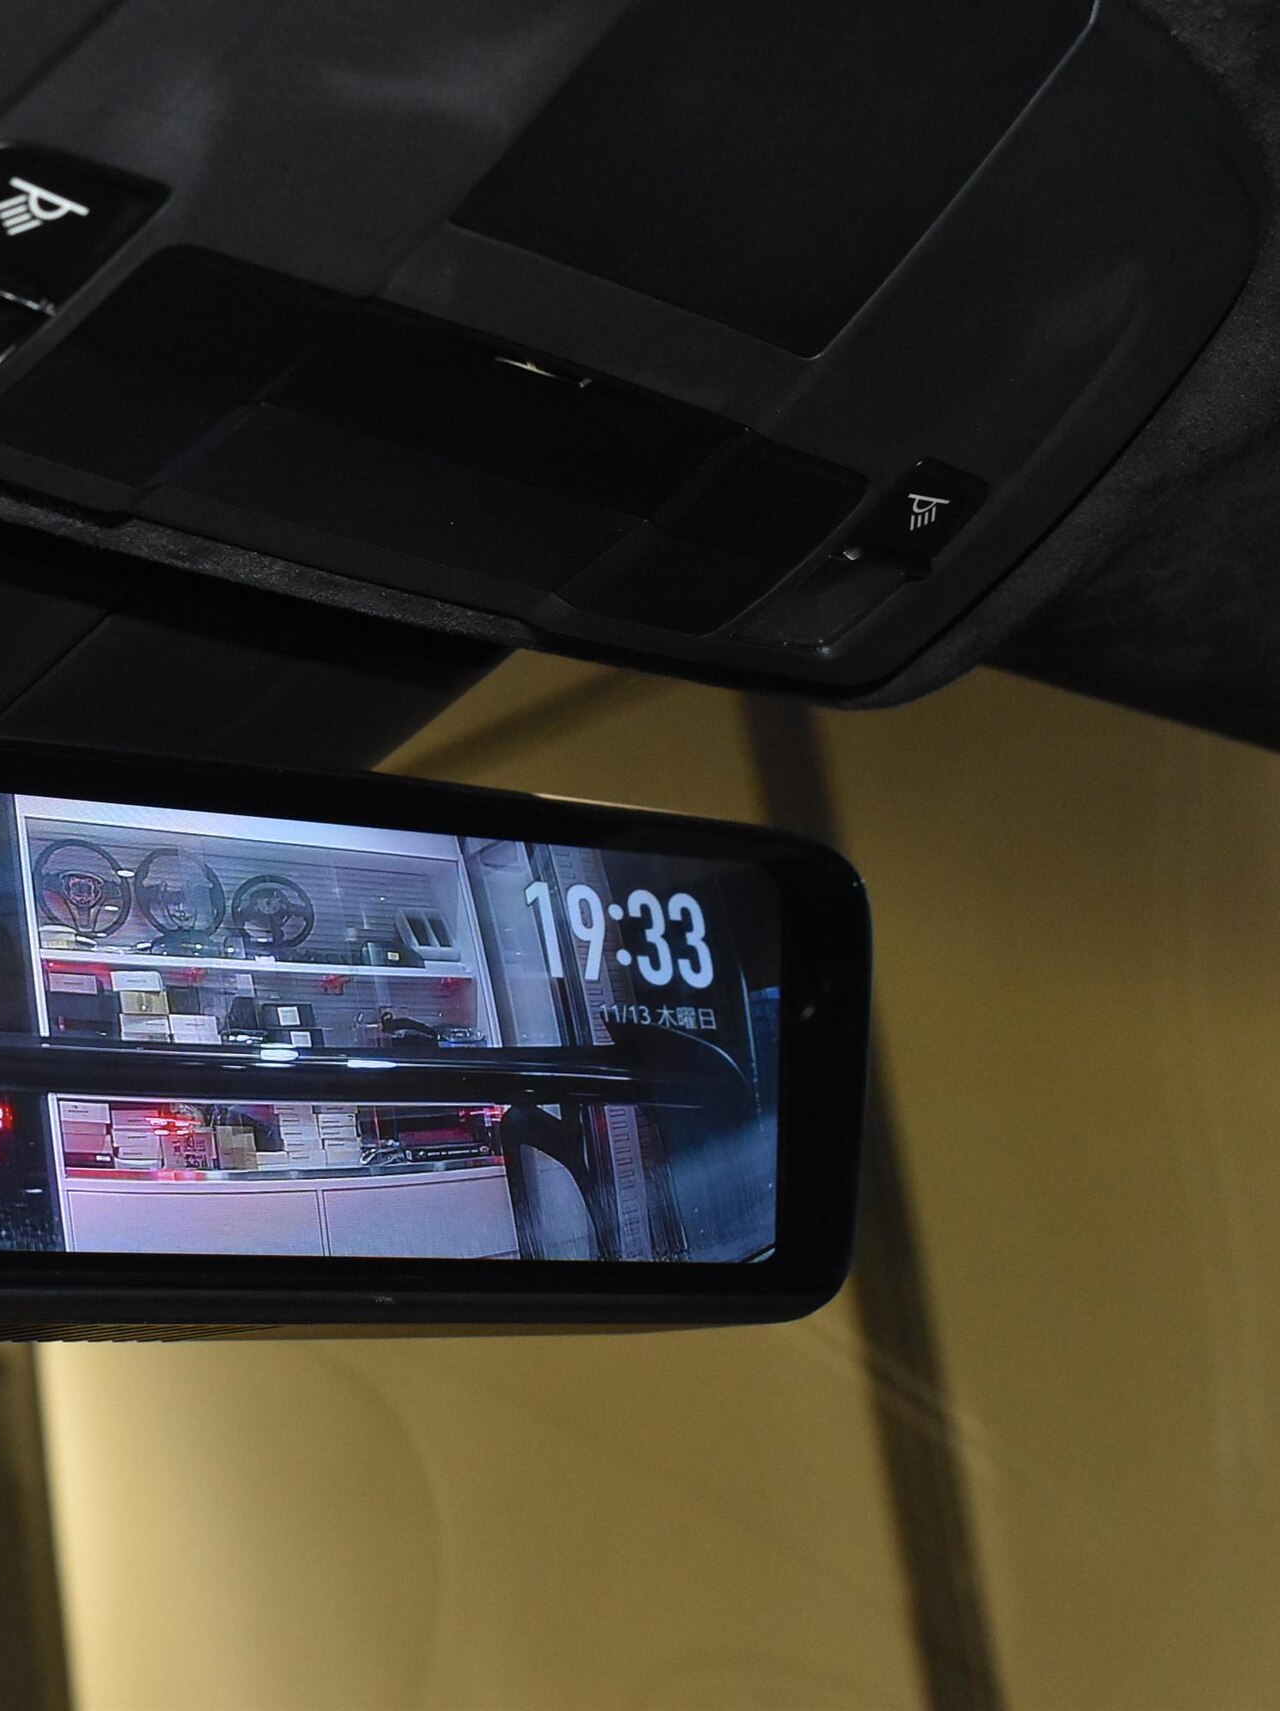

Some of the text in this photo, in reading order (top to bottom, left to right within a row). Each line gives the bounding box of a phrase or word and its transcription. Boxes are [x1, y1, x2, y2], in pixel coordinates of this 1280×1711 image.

[524, 880, 714, 989] 19:33
[599, 1003, 717, 1030] 11/13 木曜日
